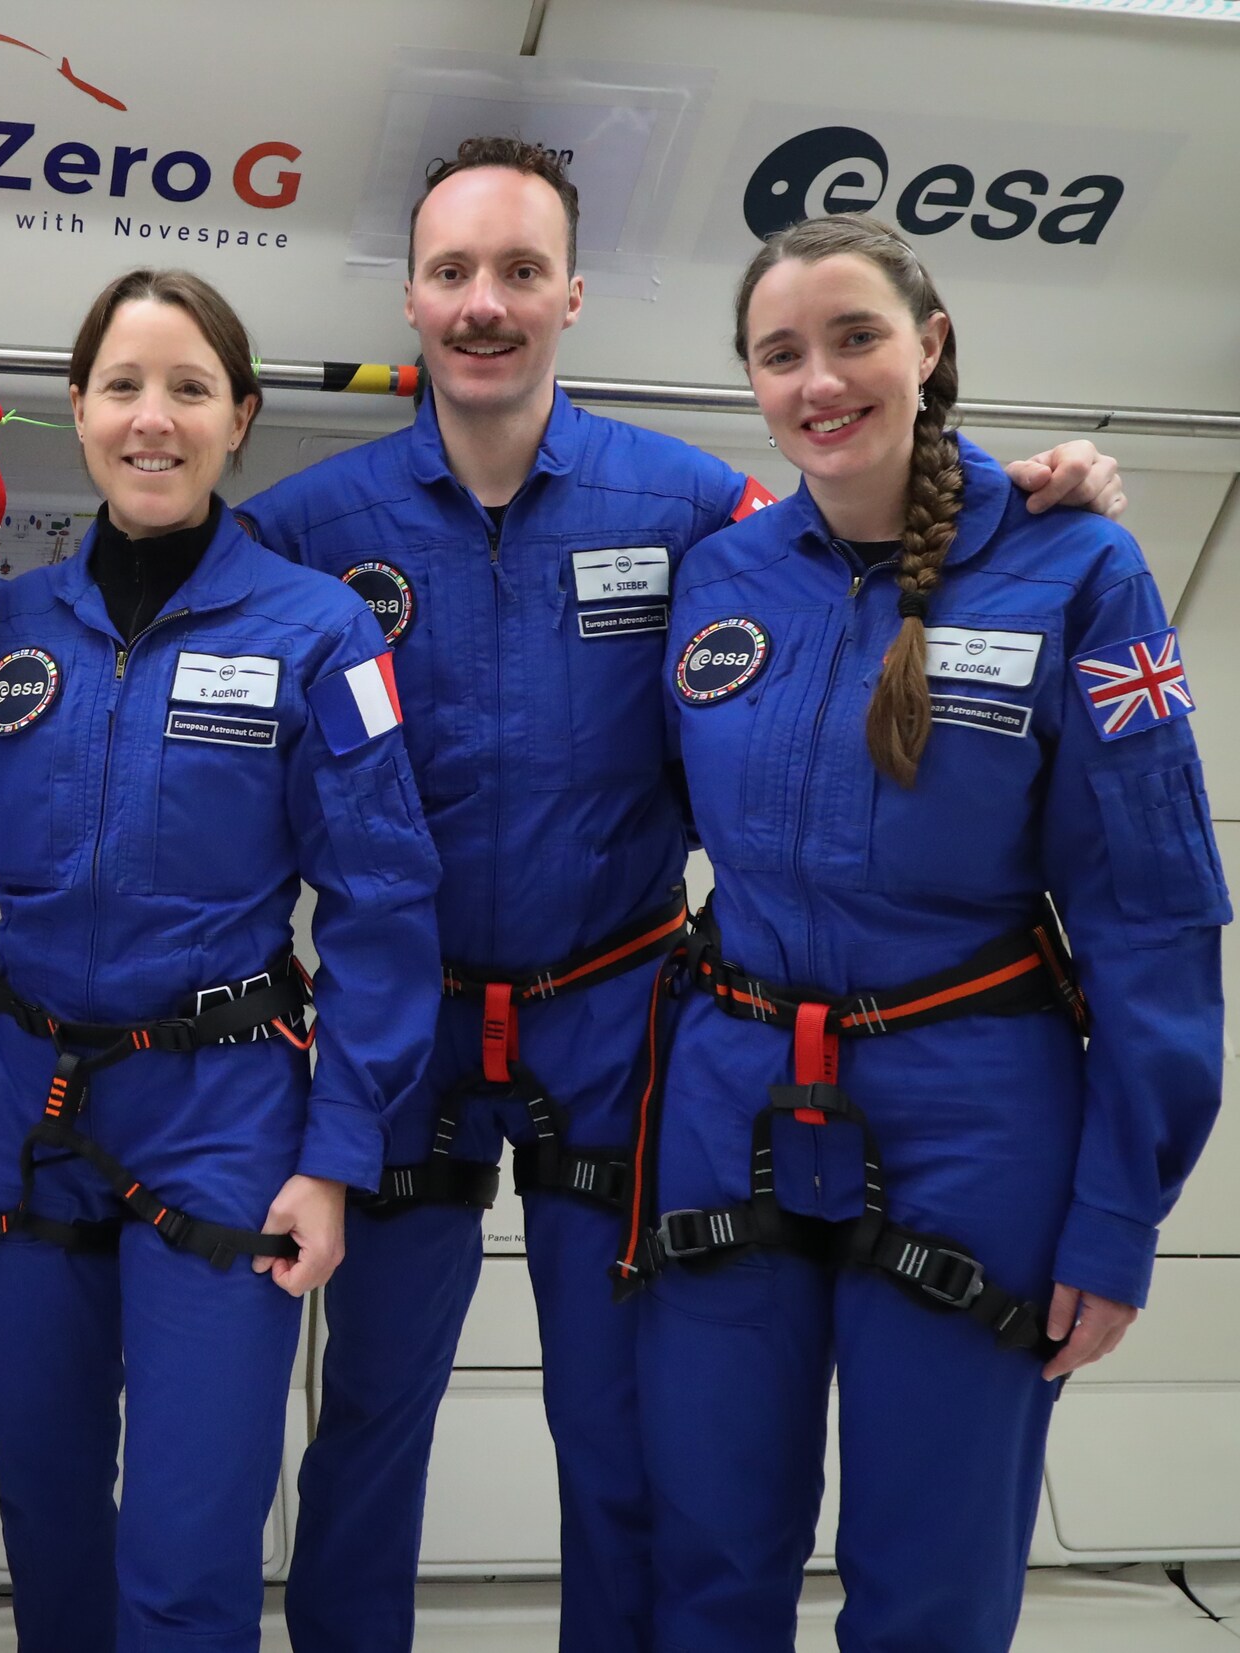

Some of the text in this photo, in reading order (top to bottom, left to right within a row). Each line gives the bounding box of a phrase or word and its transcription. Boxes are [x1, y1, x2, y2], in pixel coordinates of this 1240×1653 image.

[895, 163, 1125, 245] esa
[16, 209, 85, 234] with
[114, 216, 289, 249] Novespace
[602, 581, 648, 592] M. SIEBER
[585, 619, 617, 628] European
[711, 652, 750, 666] esa
[940, 661, 1001, 676] R. COOGAN
[10, 681, 45, 697] esa
[200, 688, 250, 698] S. ADENOT
[947, 705, 991, 719] Astronaut
[993, 713, 1020, 725] Centre
[174, 720, 271, 739] European Astronaut Centre
[487, 1233, 513, 1242] Panel
